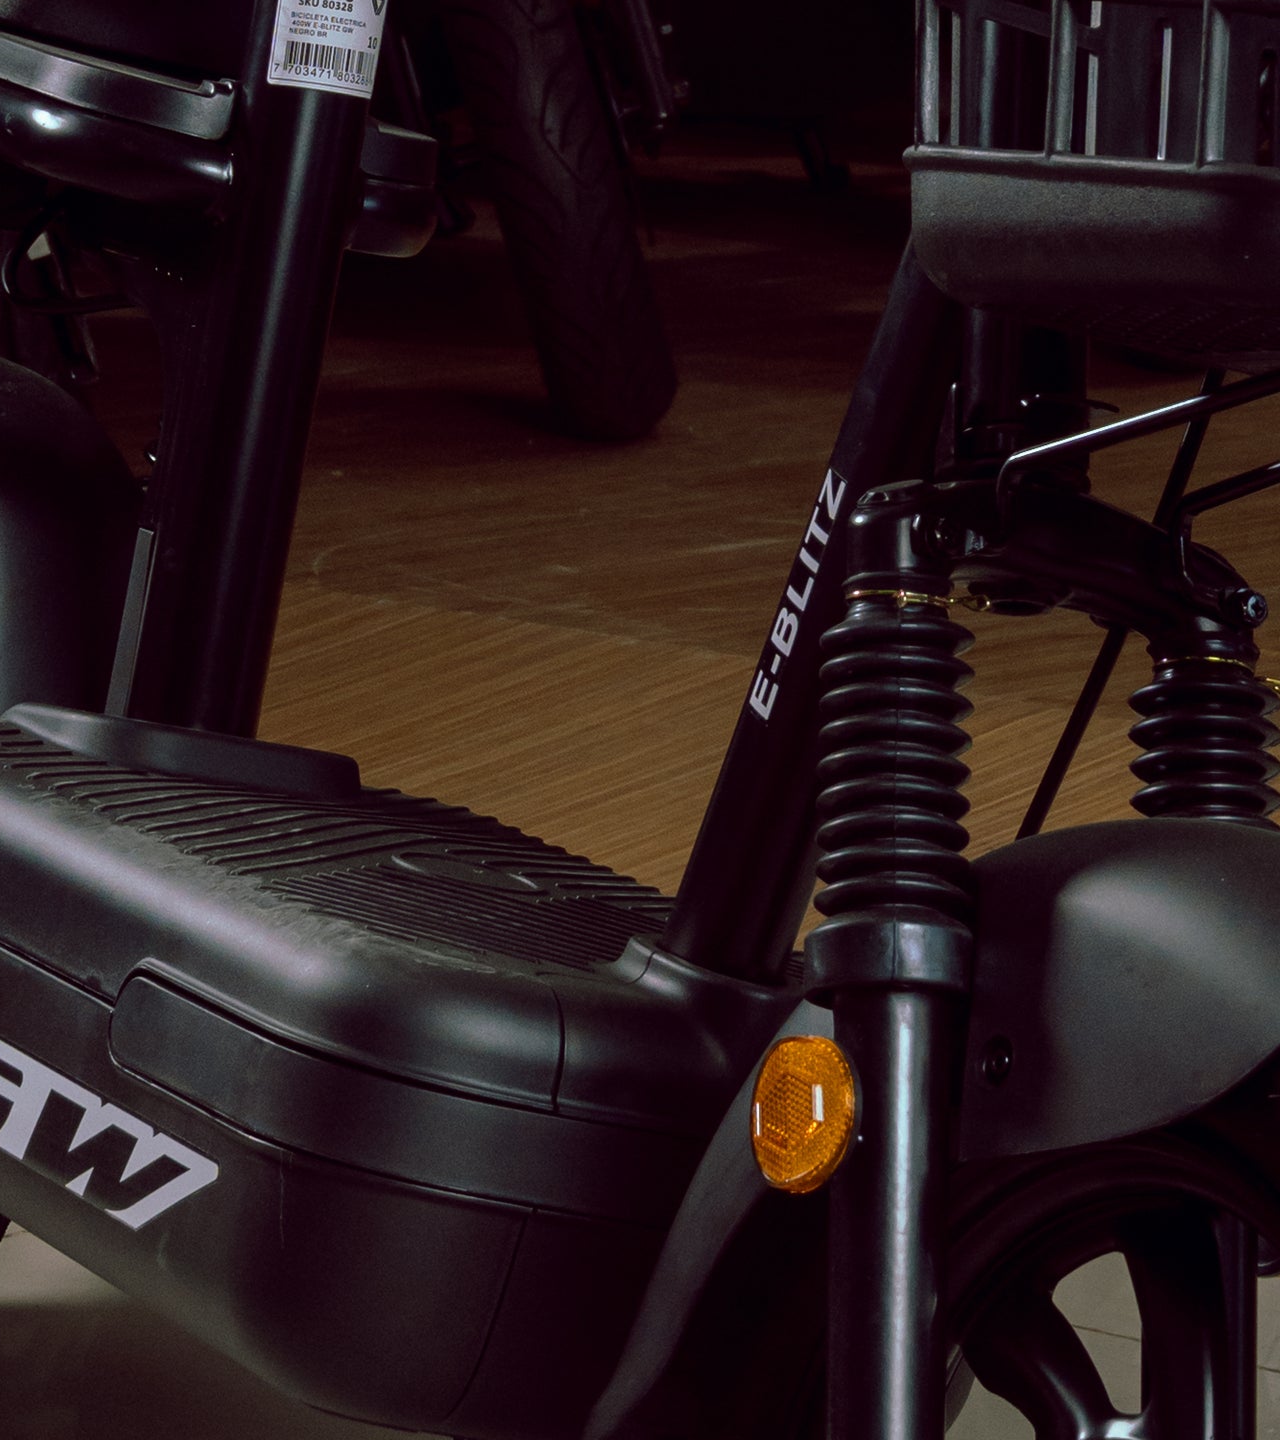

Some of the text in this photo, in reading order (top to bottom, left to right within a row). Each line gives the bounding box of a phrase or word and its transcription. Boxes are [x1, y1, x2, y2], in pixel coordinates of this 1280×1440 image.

[321, 0, 353, 12] 80328
[291, 11, 366, 27] BICICLETA ELECTRICA
[289, 27, 314, 36] NEGRO
[292, 20, 311, 28] 400W
[312, 21, 340, 32] E-BLITZ
[367, 36, 377, 49] 10
[287, 65, 331, 78] 703471
[748, 467, 849, 721] E-BLITZ
